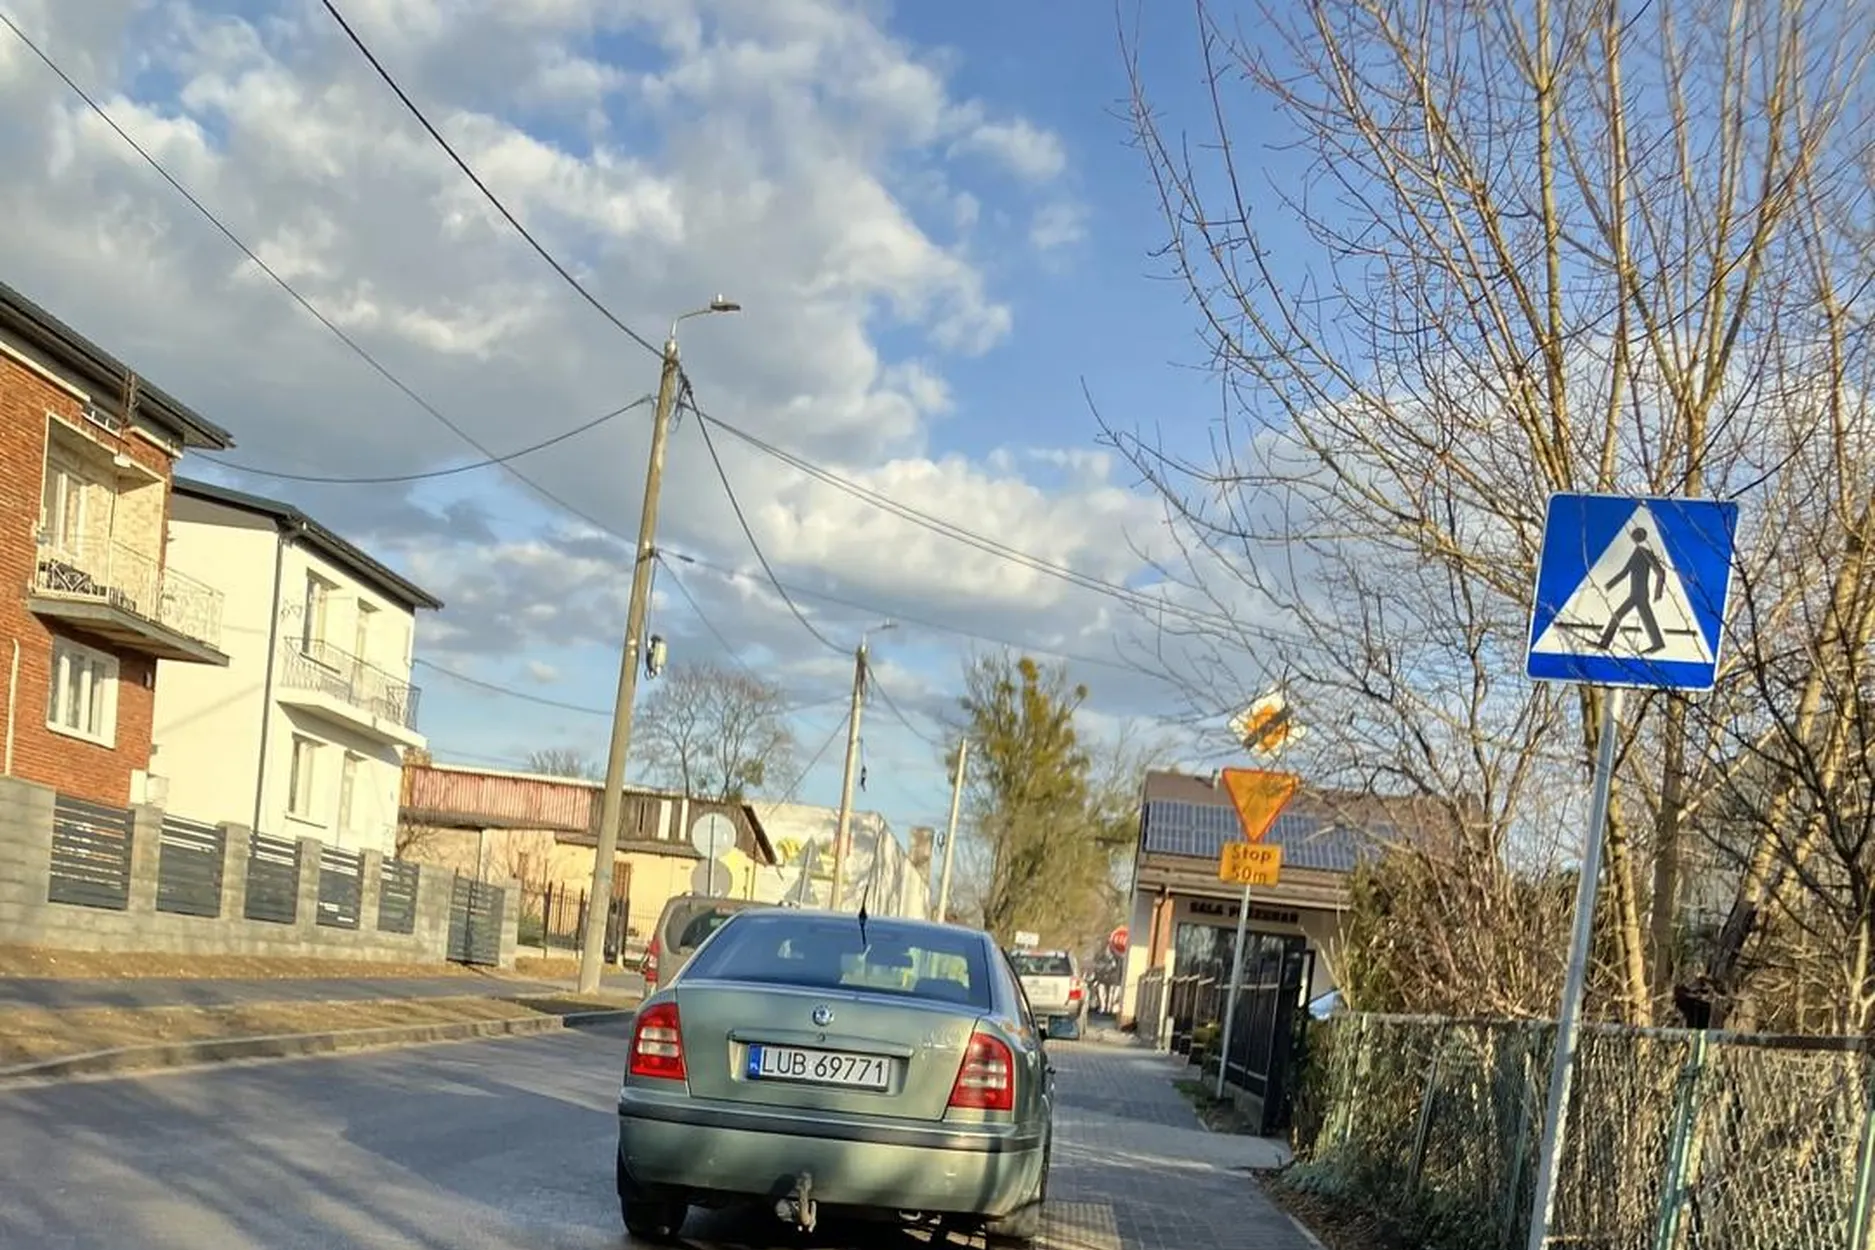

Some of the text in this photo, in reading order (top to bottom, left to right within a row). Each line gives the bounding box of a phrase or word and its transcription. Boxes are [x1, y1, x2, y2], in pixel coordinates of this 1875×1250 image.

[1232, 845, 1271, 864] Stop
[1231, 864, 1266, 884] 50m
[762, 1049, 883, 1083] LUB 69771
